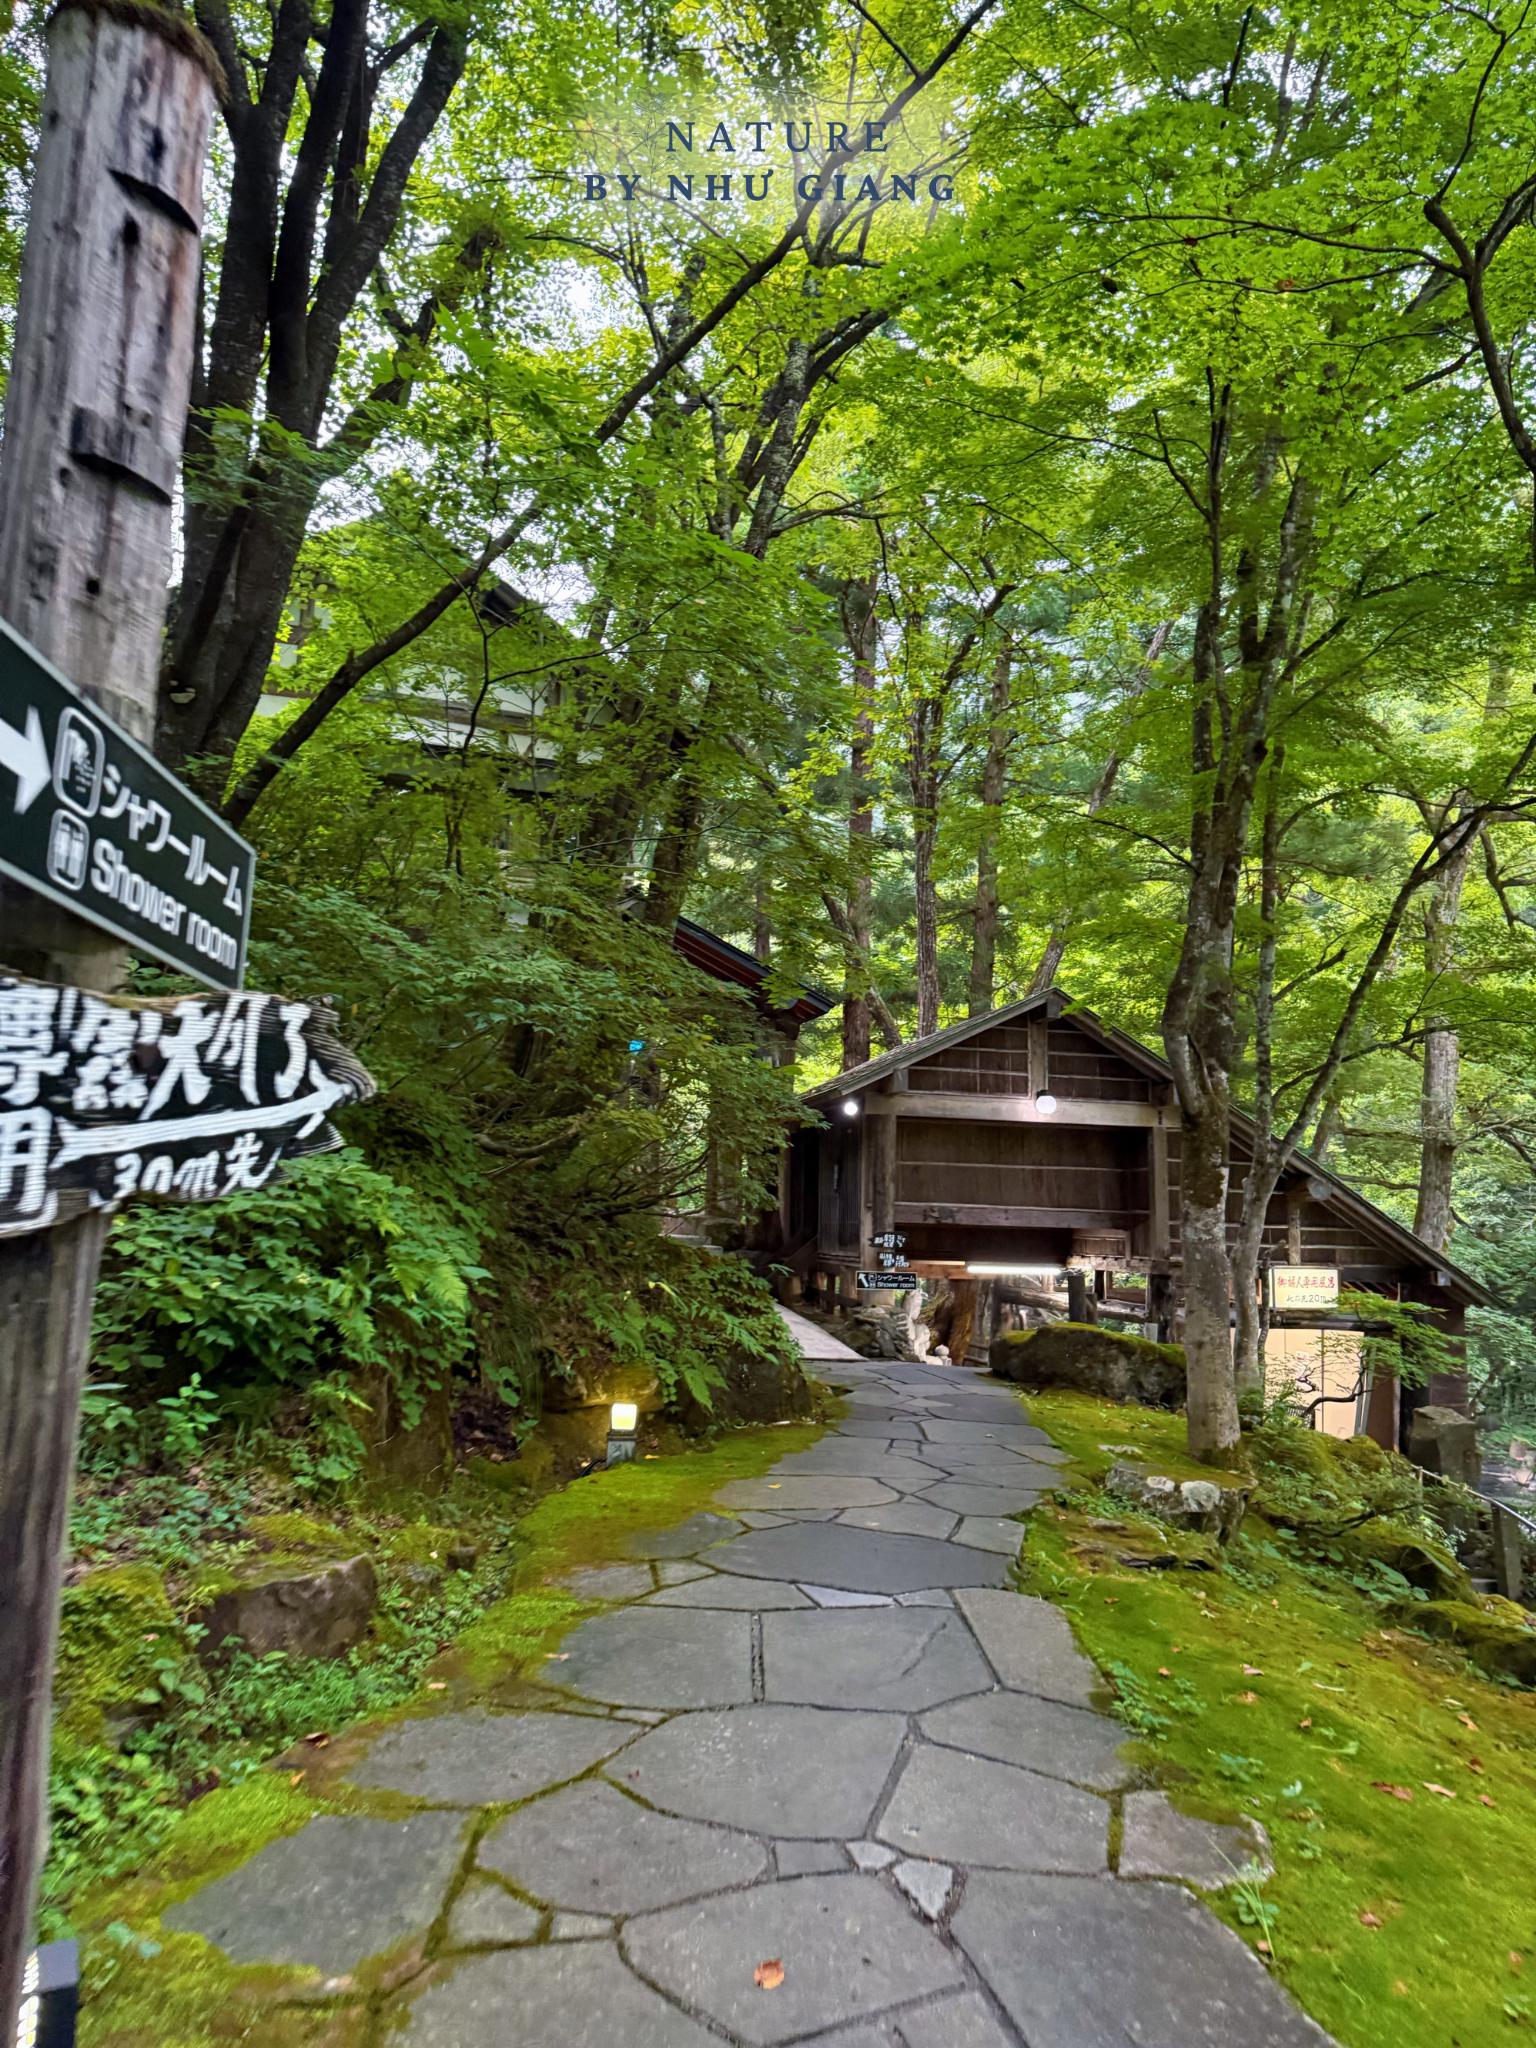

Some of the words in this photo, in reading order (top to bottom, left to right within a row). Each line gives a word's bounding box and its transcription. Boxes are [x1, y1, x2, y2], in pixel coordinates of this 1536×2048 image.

[91, 838, 187, 936] Shower
[185, 912, 237, 970] room
[100, 763, 242, 916] シャワールーム
